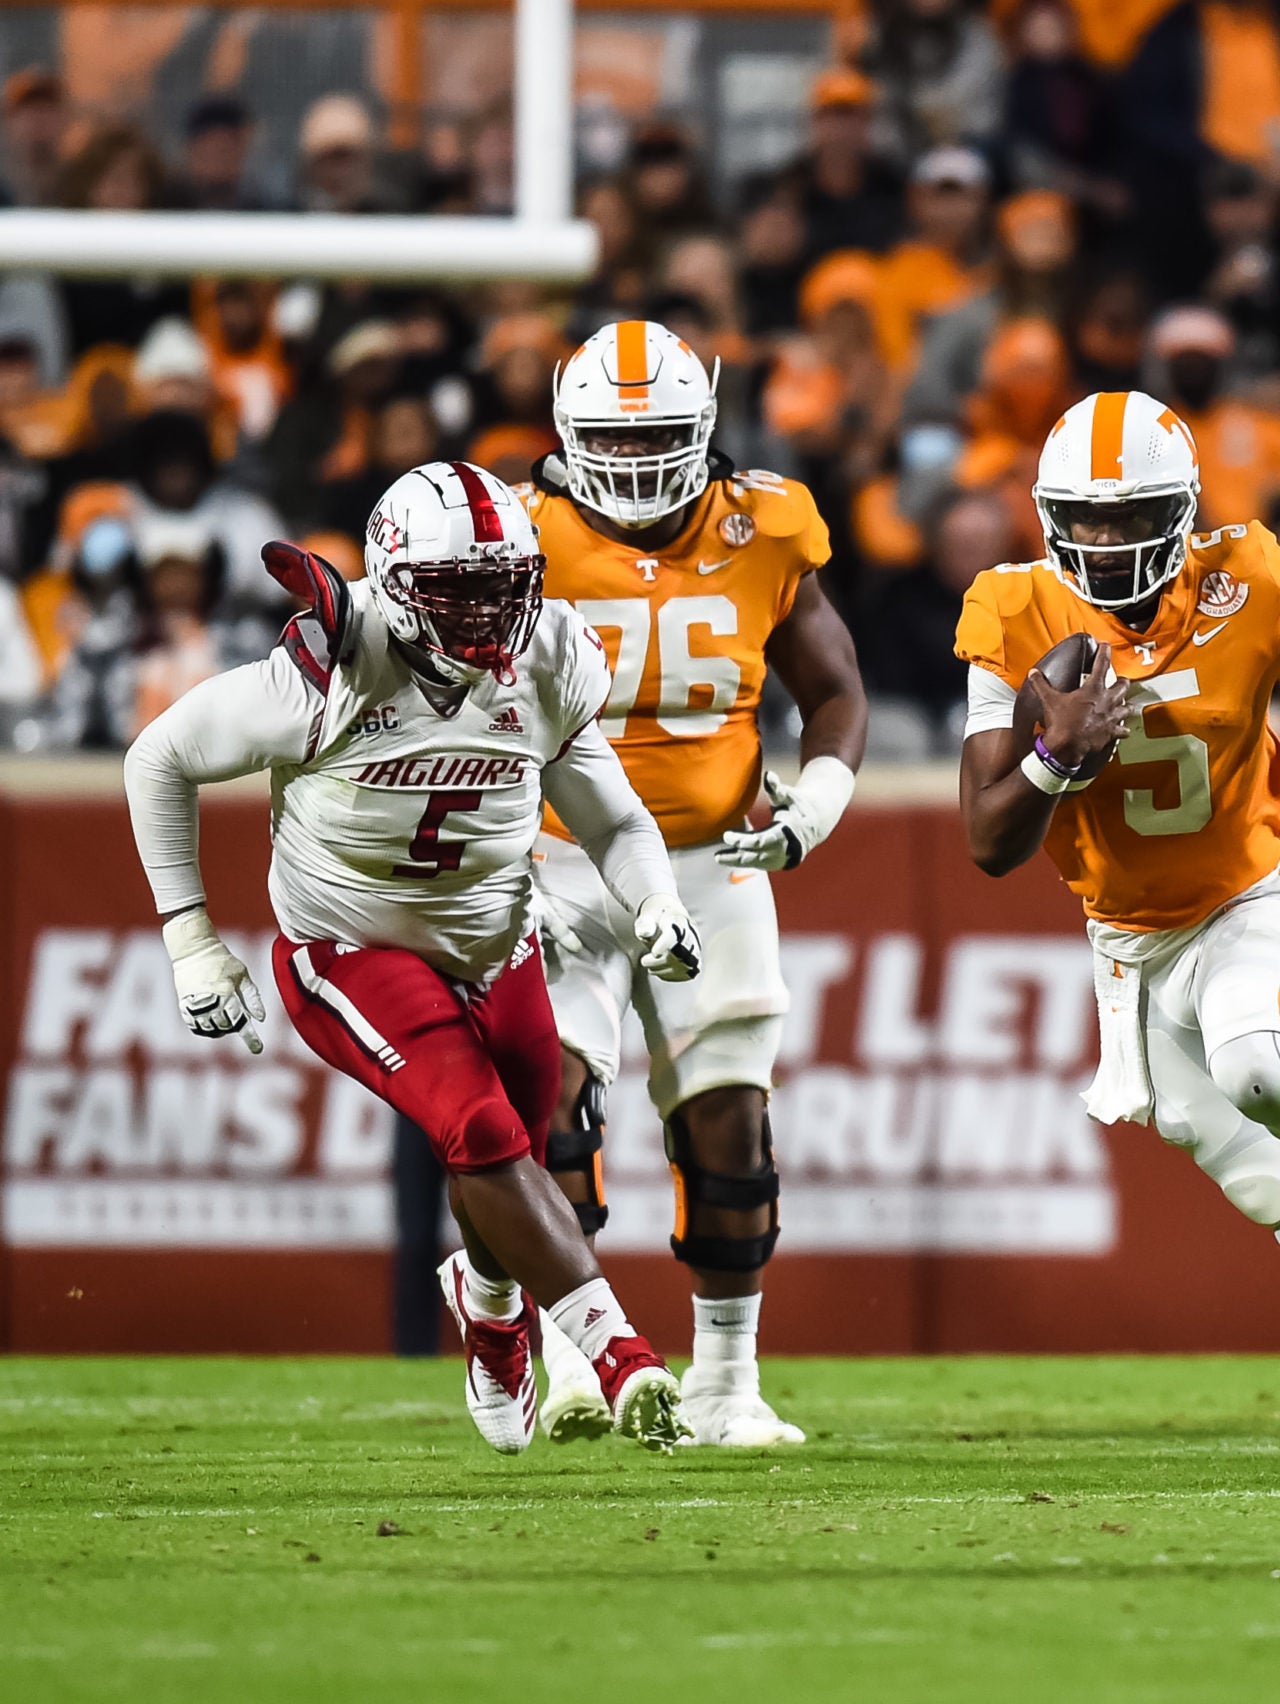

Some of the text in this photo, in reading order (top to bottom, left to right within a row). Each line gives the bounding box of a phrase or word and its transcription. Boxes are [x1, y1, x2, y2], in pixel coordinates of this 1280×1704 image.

[636, 559, 660, 580] T
[1201, 571, 1237, 605] SEC
[577, 596, 741, 737] 76
[1134, 641, 1157, 666] T
[488, 722, 524, 734] adidas
[1116, 668, 1212, 836] 5
[349, 757, 530, 788] JAGUARS
[392, 790, 483, 880] 5
[6, 1070, 306, 1170] FANS
[772, 1070, 1112, 1170] RUNK
